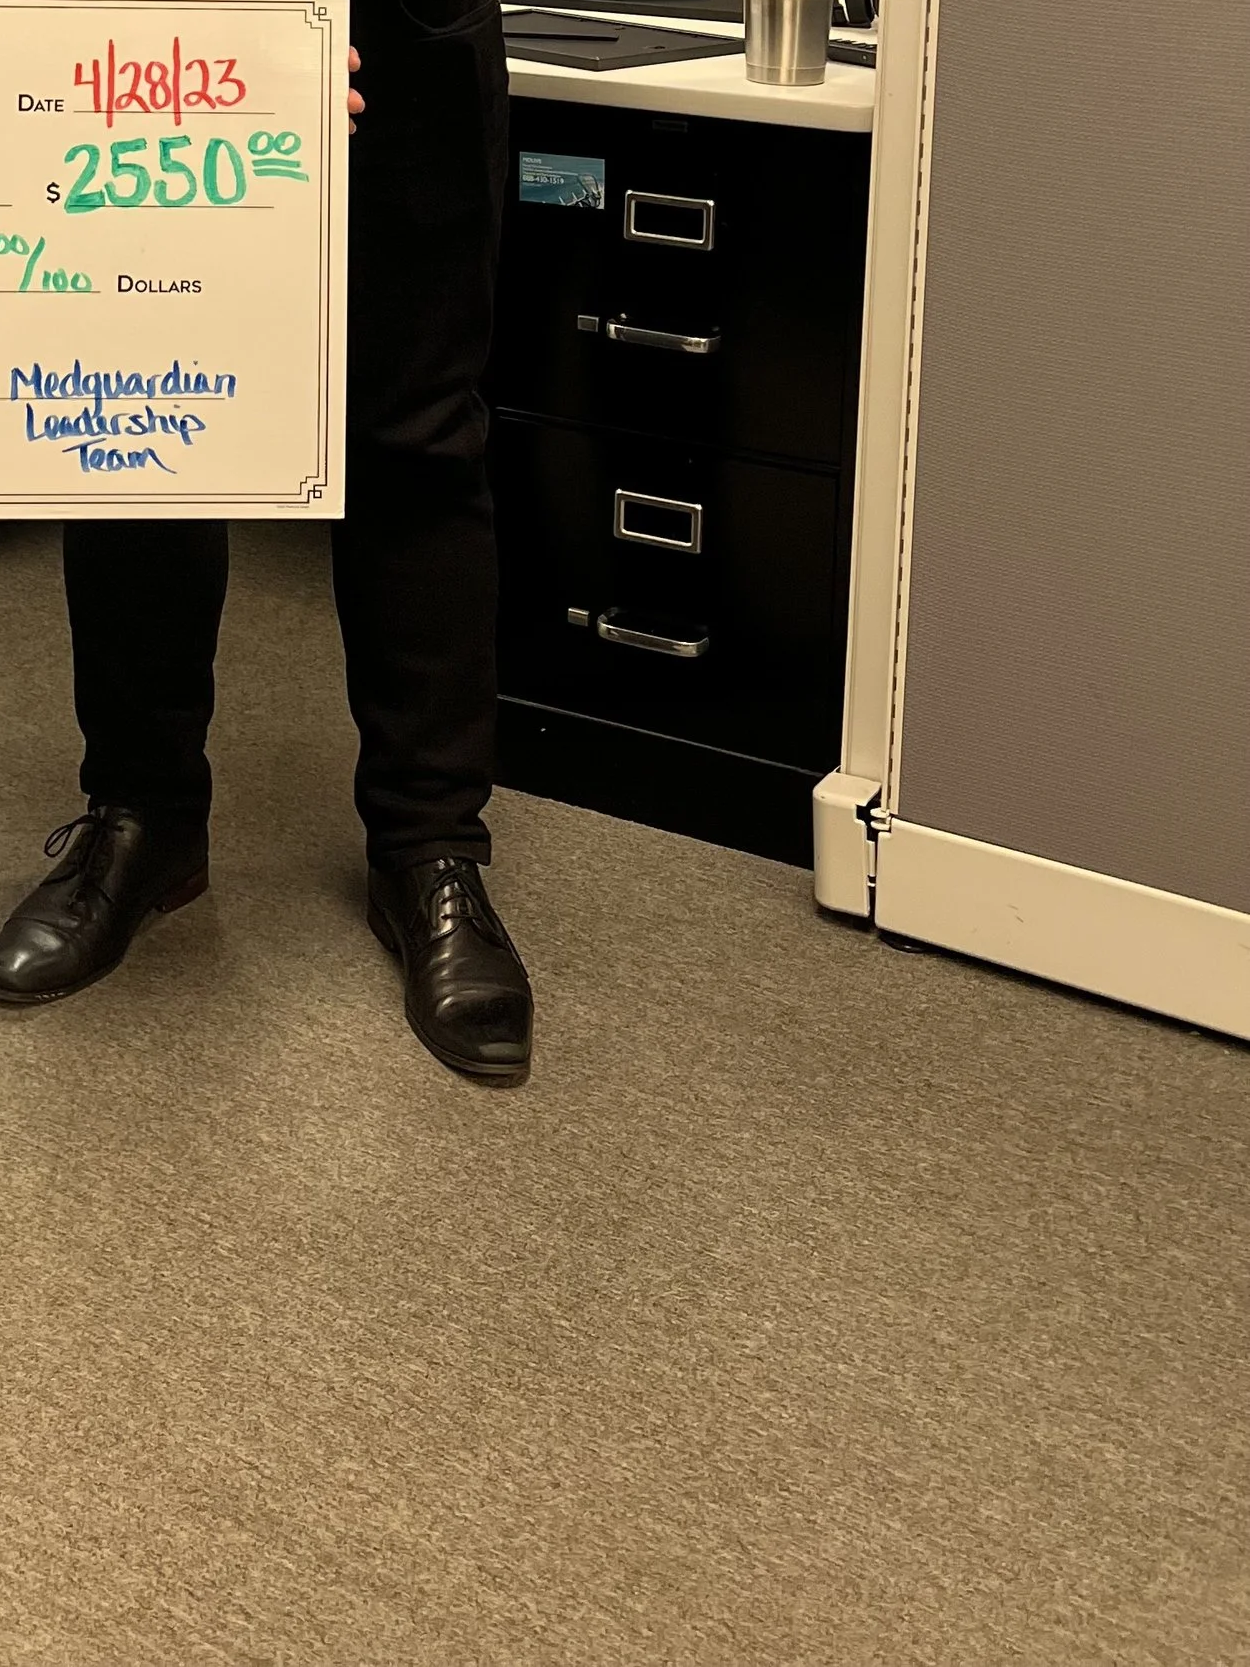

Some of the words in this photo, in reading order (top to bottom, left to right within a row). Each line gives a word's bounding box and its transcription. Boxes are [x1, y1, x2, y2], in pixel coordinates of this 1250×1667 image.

[73, 36, 247, 128] 4/28/23
[46, 182, 61, 203] $
[10, 359, 237, 418] Medguardian
[62, 438, 178, 474] Team
